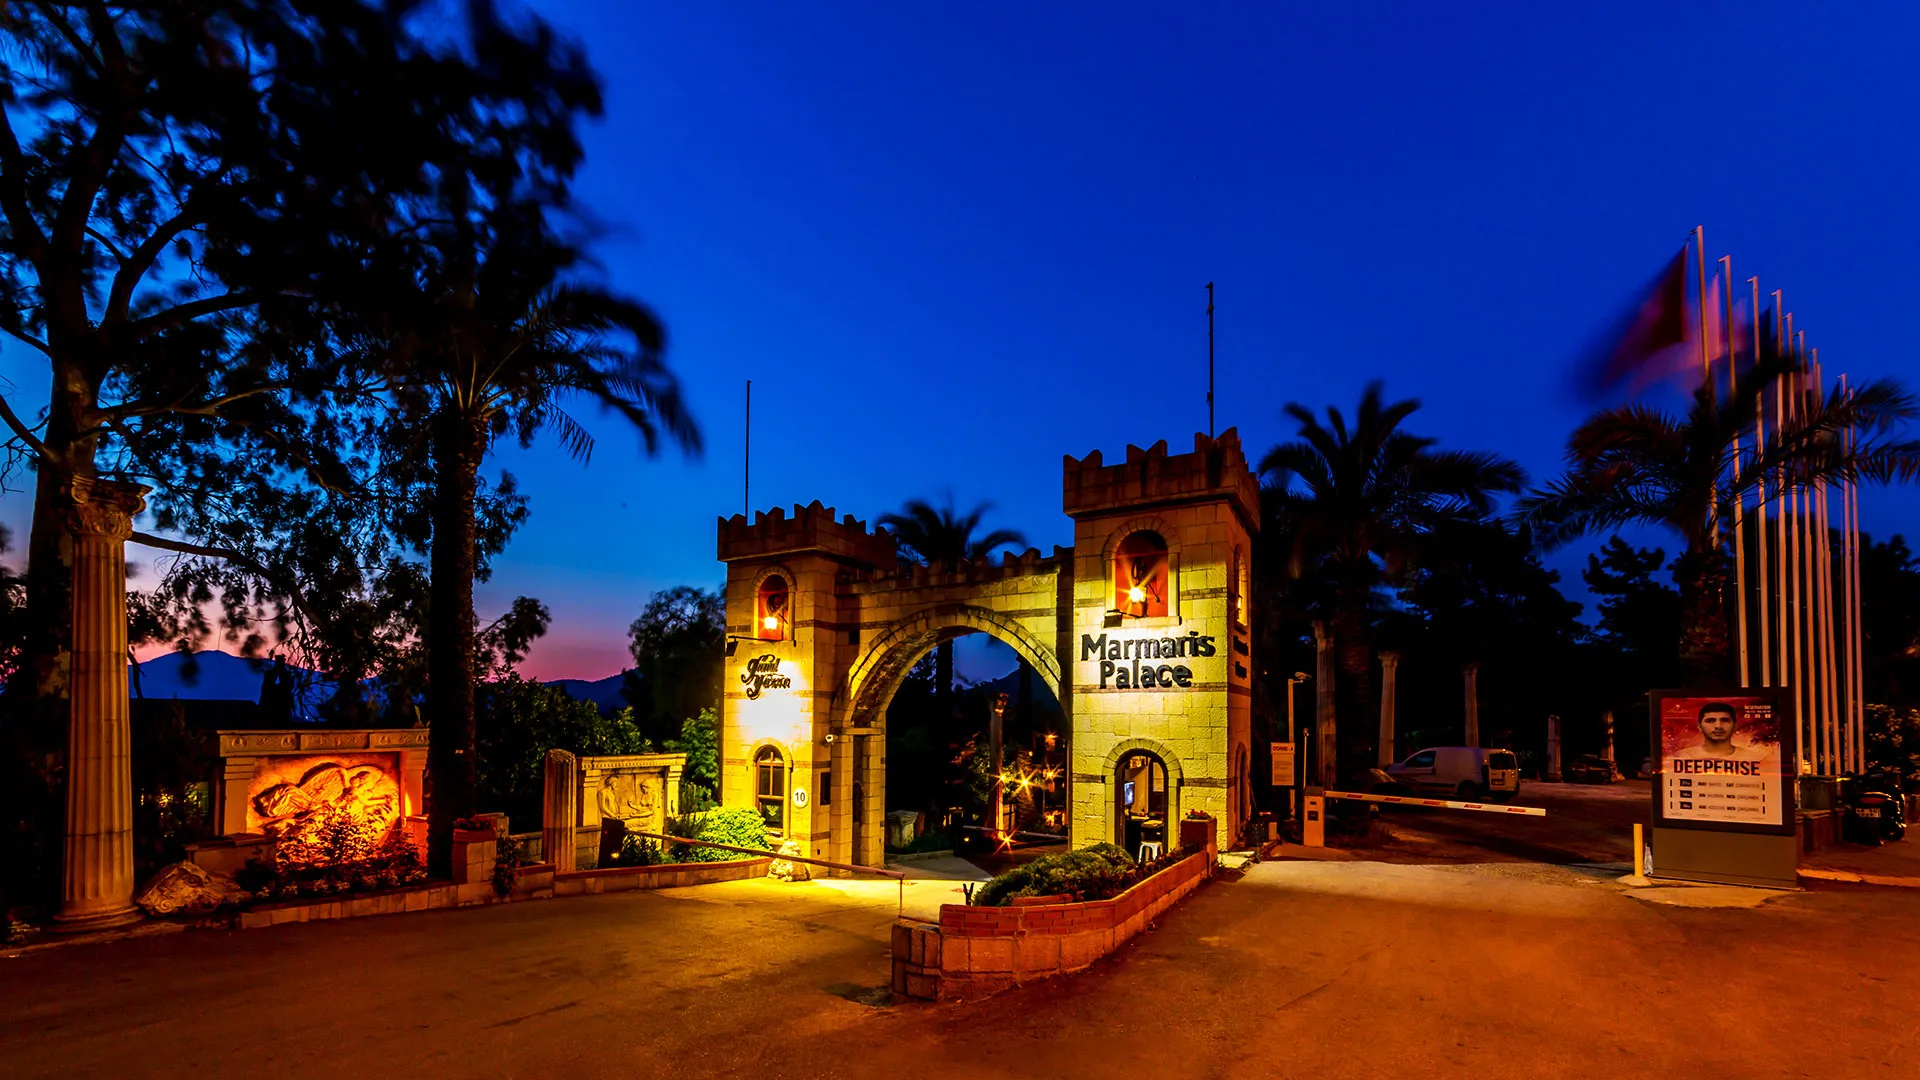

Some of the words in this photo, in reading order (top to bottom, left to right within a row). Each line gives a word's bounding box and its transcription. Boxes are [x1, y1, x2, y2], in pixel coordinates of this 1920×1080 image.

[1081, 631, 1217, 661] Marmaris
[1100, 660, 1193, 689] Palace
[795, 791, 806, 802] 10
